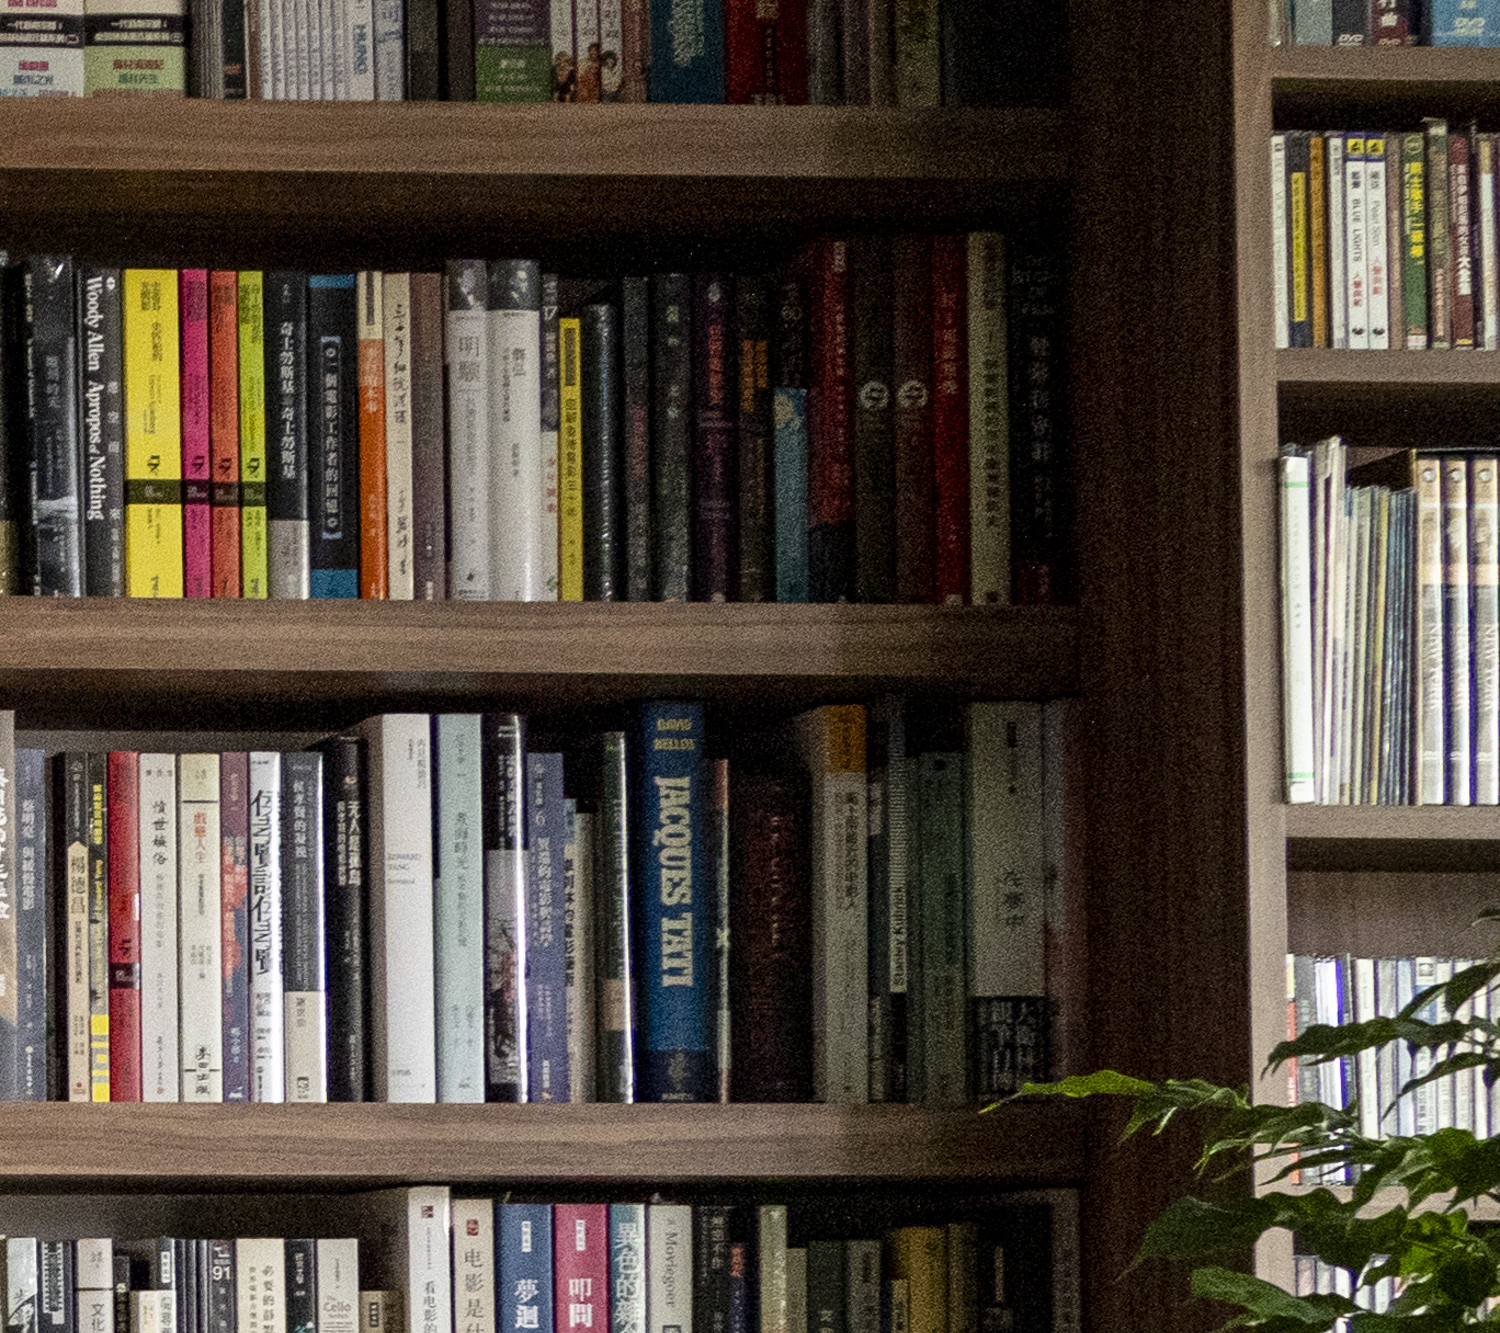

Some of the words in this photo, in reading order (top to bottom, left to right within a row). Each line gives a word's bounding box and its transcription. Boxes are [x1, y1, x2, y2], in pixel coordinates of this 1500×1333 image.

[86, 276, 104, 326] Woody
[86, 329, 104, 371] Allen
[86, 381, 104, 437] Apropos
[87, 456, 106, 521] Nothing
[654, 776, 693, 906] JACQUES
[661, 912, 694, 988] TATI
[213, 1266, 231, 1280] 91
